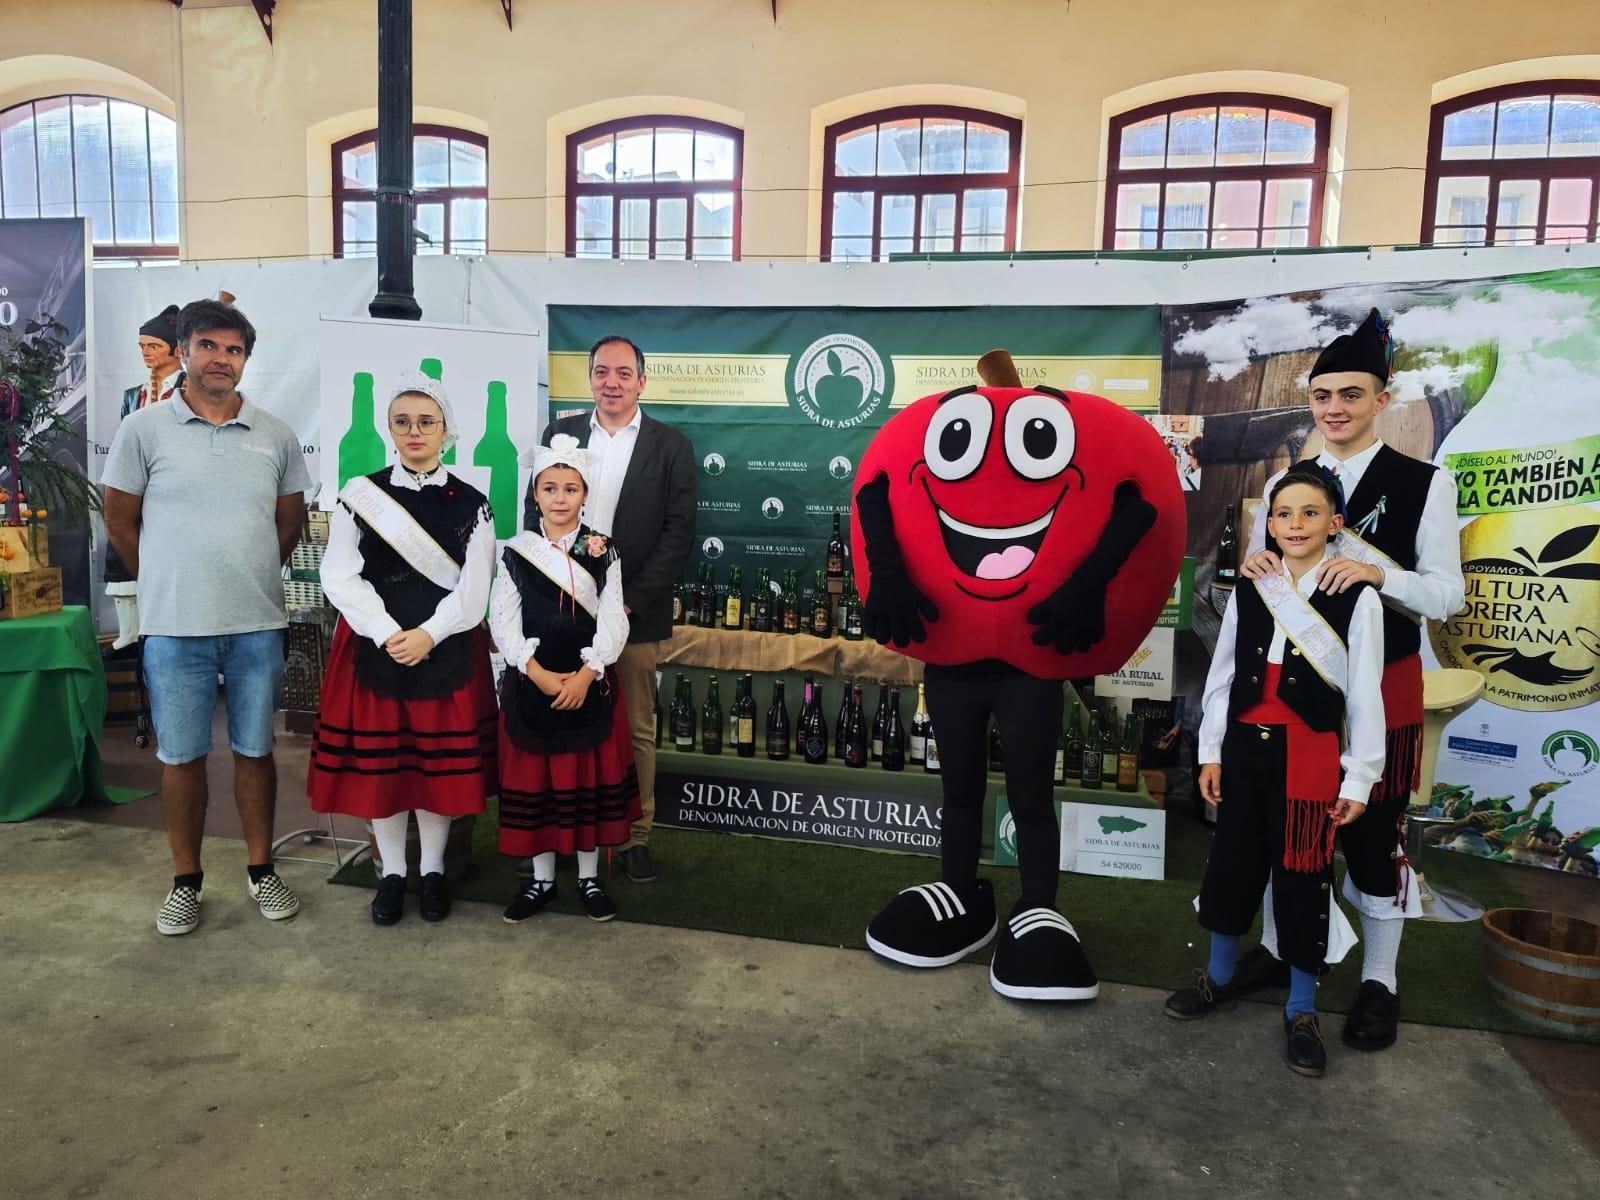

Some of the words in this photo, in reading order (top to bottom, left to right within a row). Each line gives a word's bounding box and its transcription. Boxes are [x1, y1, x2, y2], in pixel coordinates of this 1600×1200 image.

[646, 363, 683, 374] SIDRA
[687, 364, 699, 375] DE
[704, 364, 766, 376] ASTURIAS
[916, 367, 957, 378] SIDRA
[961, 367, 977, 378] DE
[797, 395, 820, 423] SIDRA
[821, 418, 833, 428] DE
[837, 396, 881, 429] ASTURIAS
[1495, 455, 1508, 464] AL
[1511, 450, 1557, 464] MUNDO!
[1455, 470, 1477, 488] YO
[1483, 456, 1584, 487] TAMBIÉN
[1456, 489, 1480, 508] LA
[1438, 622, 1572, 646] ASTURIANA
[1129, 670, 1164, 681] RURAL
[1498, 688, 1567, 703] PATRIMONIO
[1544, 756, 1557, 772] SIDRA
[1567, 763, 1597, 777] ASTURIAS
[681, 782, 763, 811] SIDRA
[771, 790, 804, 815] DE
[679, 809, 789, 831] DENOMINACION
[793, 820, 809, 833] DE
[812, 822, 865, 840] ORIGEN
[1085, 838, 1109, 847] SIDRA
[1123, 841, 1160, 850] ASTURIAS
